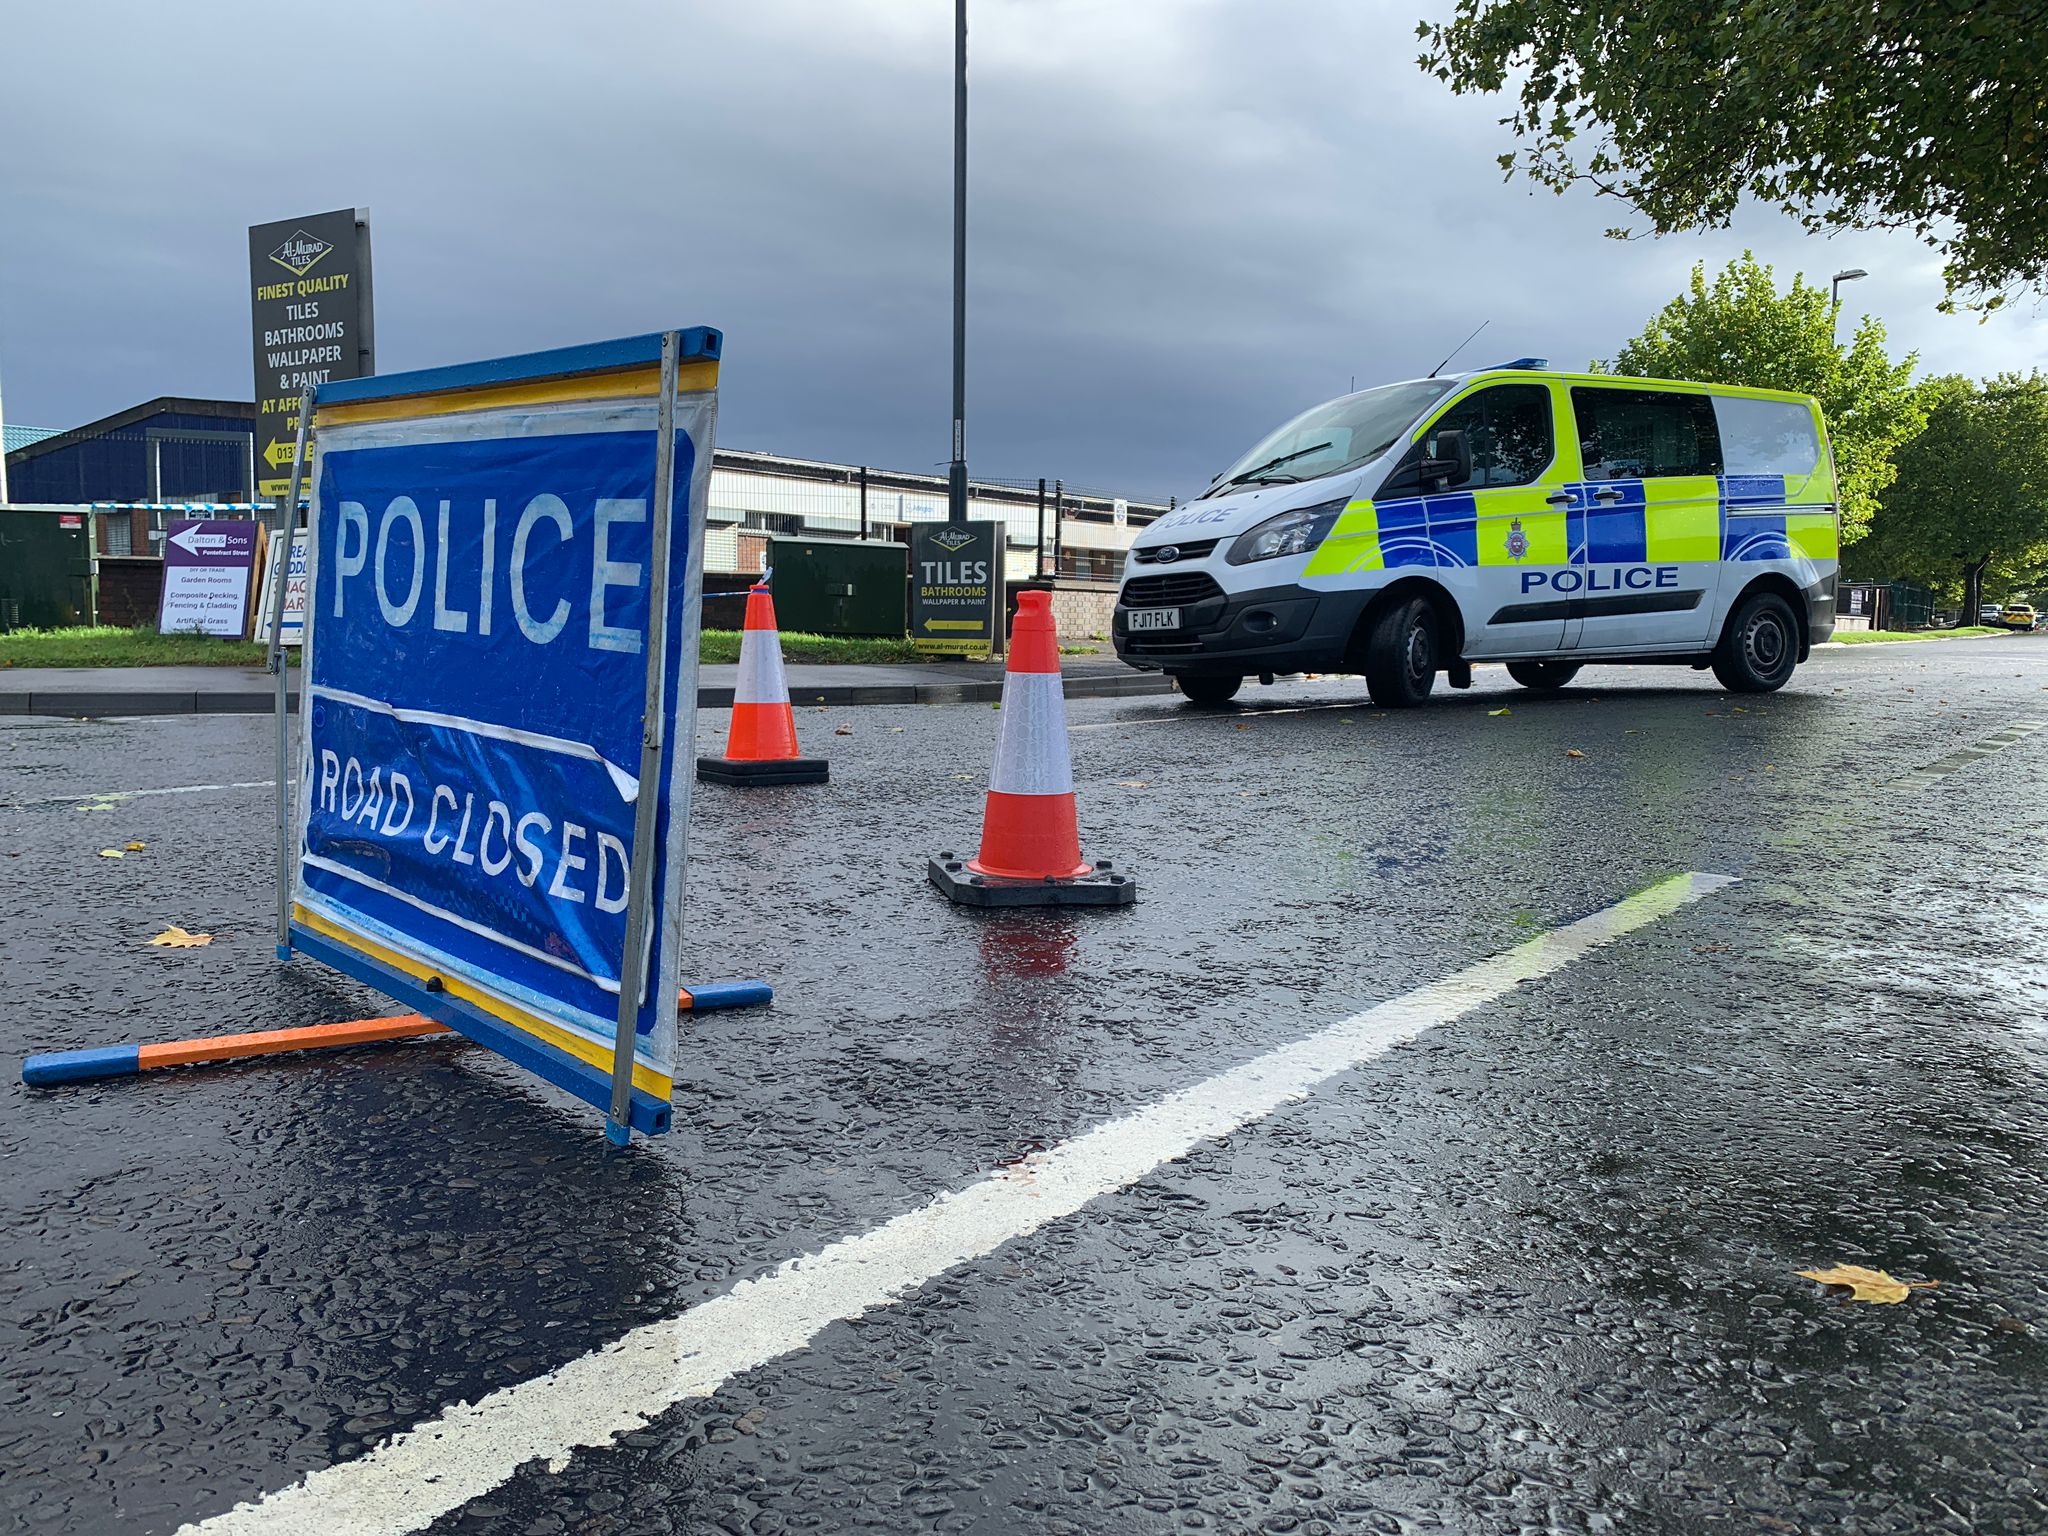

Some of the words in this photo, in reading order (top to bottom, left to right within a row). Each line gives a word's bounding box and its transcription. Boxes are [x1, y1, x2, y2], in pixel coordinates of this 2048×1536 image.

[291, 255, 311, 266] TILES
[257, 282, 295, 301] FINEST
[297, 274, 349, 297] QUALITY
[286, 302, 319, 321] TILES
[264, 321, 344, 347] BATHROOMS
[267, 345, 342, 369] WALLPAPER
[279, 374, 290, 390] &
[292, 369, 331, 389] PAINT
[261, 400, 276, 414] AT
[1151, 508, 1238, 533] POLICE
[187, 535, 216, 544] Dalton
[218, 535, 225, 543] &
[226, 535, 248, 545] Sons
[181, 576, 207, 584] Garden
[207, 576, 232, 584] Rooms
[333, 493, 647, 654] POLICE
[921, 561, 987, 584] TILES
[1521, 567, 1679, 594] POLICE
[170, 592, 208, 600] Composite
[921, 586, 987, 597] BATHROOMS
[170, 602, 198, 610] Fencing
[206, 602, 238, 610] Cladding
[1132, 612, 1153, 628] FJ17
[1154, 611, 1174, 627] FLK
[918, 642, 988, 651] www.al-murad.co.uk
[320, 749, 414, 837] ROAD
[423, 784, 630, 914] CLOSED
